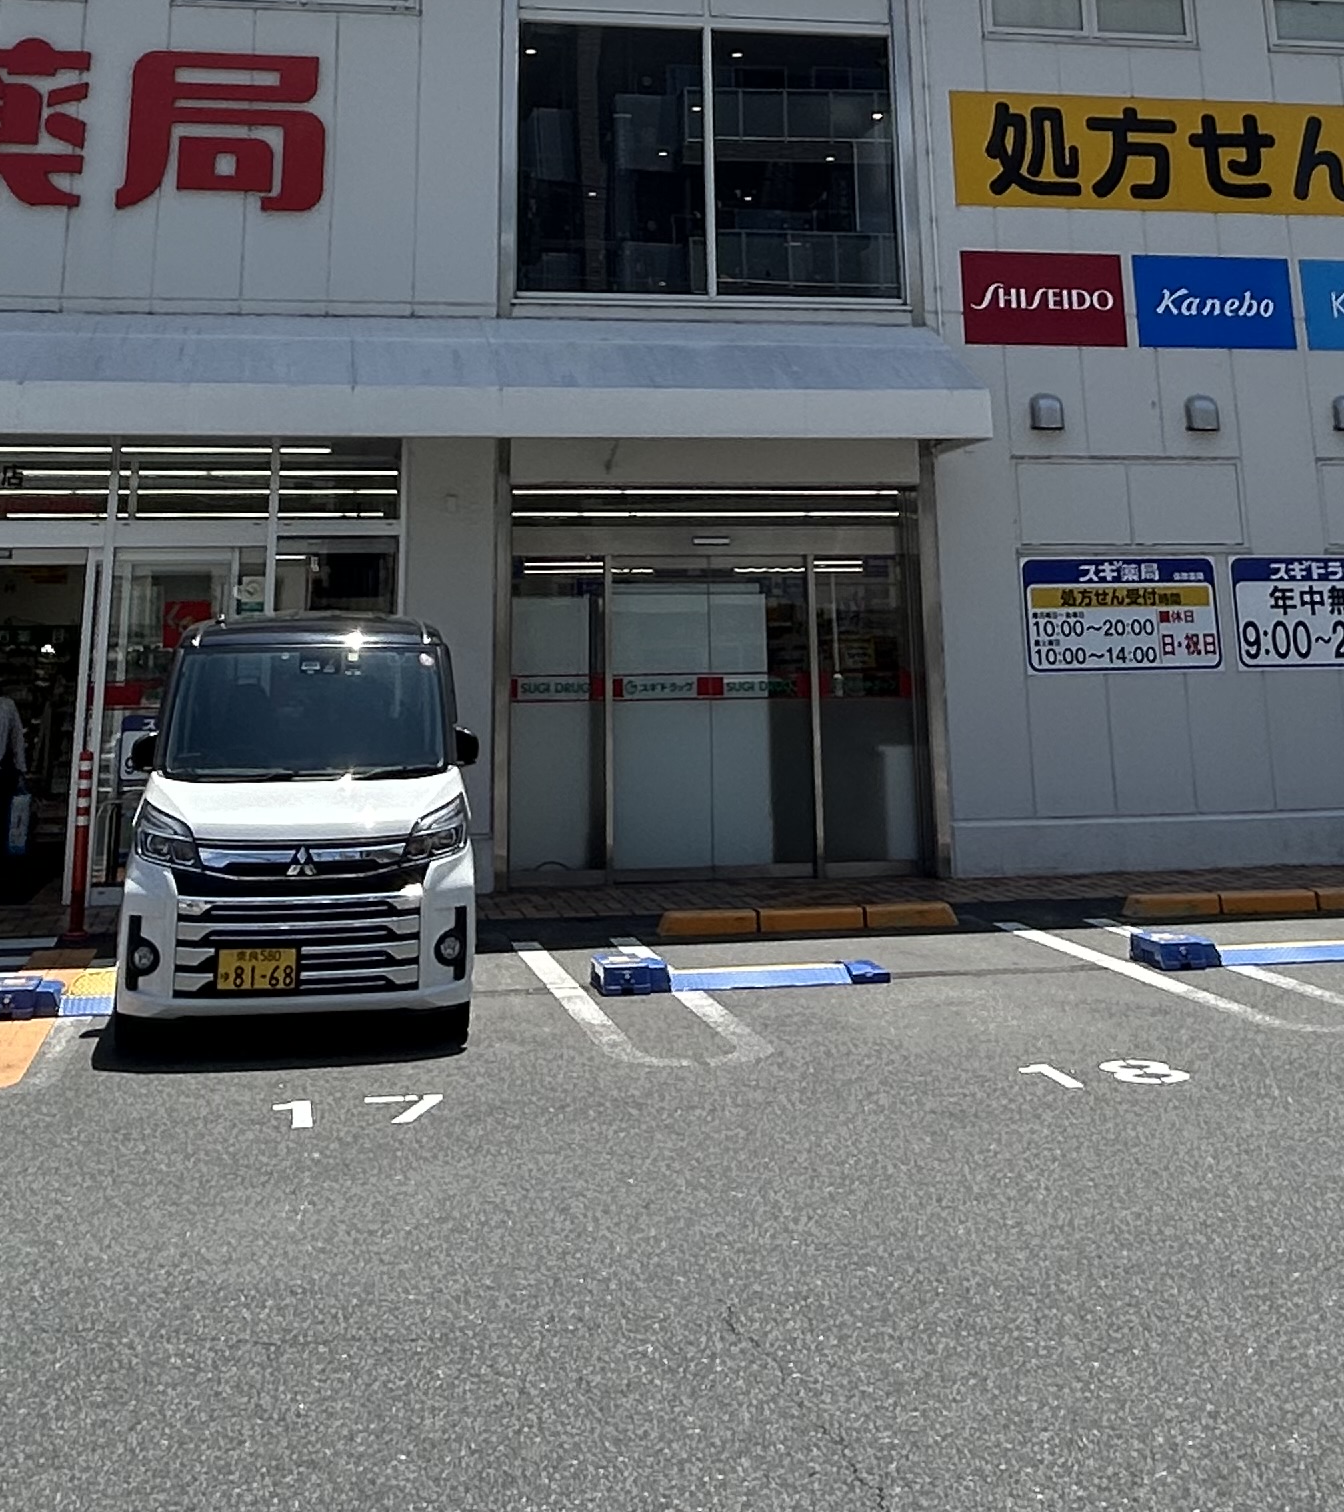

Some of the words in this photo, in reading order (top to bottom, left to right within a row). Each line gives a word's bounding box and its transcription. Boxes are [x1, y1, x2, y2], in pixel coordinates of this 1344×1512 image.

[970, 282, 1114, 313] SHISEIDO
[1156, 288, 1275, 318] Kanebo
[1078, 561, 1160, 582] スギ薬局
[233, 965, 294, 988] 81-68
[1019, 1059, 1191, 1088] 18
[272, 1094, 443, 1129] 17
